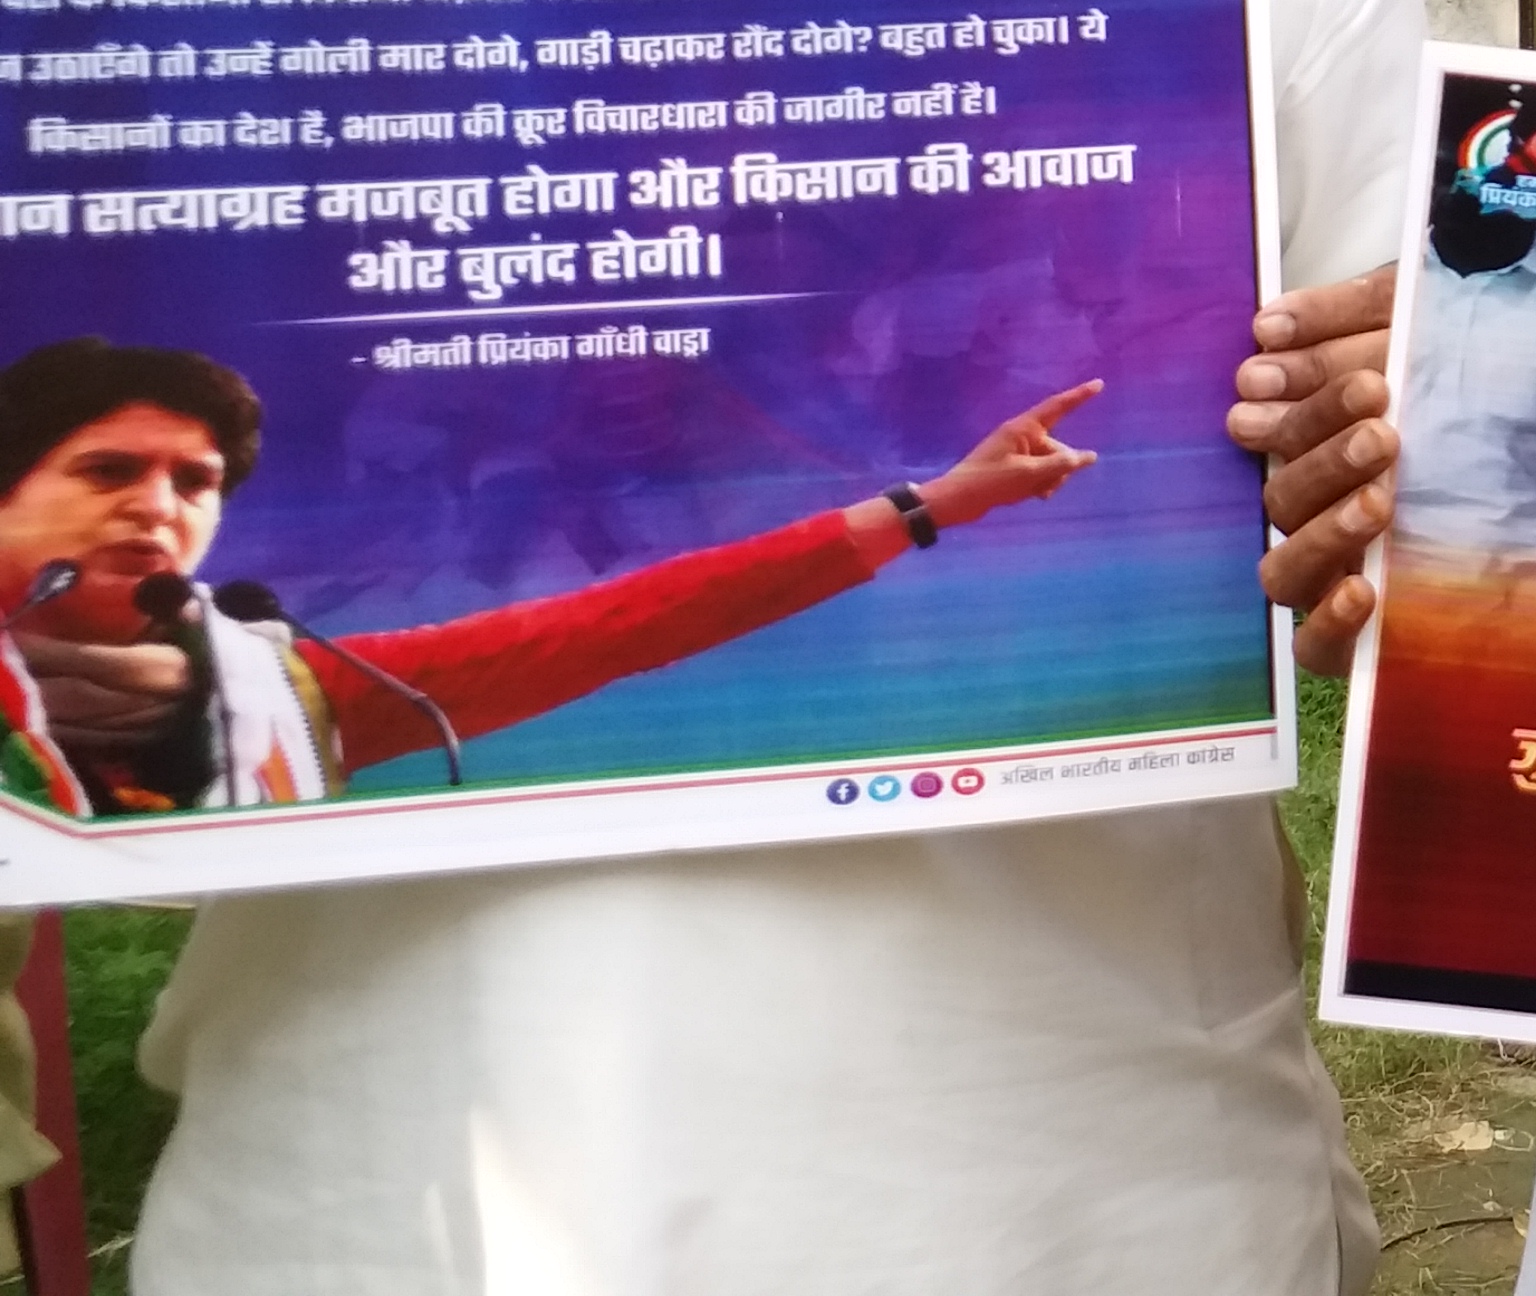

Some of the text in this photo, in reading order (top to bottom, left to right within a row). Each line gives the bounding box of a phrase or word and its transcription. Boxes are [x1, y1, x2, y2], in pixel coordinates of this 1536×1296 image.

[157, 8, 1108, 79] तो उन्हें गोली मार दोगे, गाड़ी चढ़ाकर रौंद दोगे? बहुत हो चुका। ये
[27, 80, 996, 153] किसानों का देश है, भाजपा की क्रूर विचारधारा की जागीर नहीं है।
[78, 142, 1137, 234] सत्याग्रह मजबूत होगा और किसान की आवाज
[347, 226, 722, 302] और बुलंद होगी।
[373, 335, 474, 371] श्रीमती
[476, 331, 571, 365] प्रियंका
[652, 326, 712, 358] वाड्रा
[1000, 763, 1054, 786] अखिल
[1060, 756, 1121, 778] भारतीय
[1127, 750, 1180, 772] महिला
